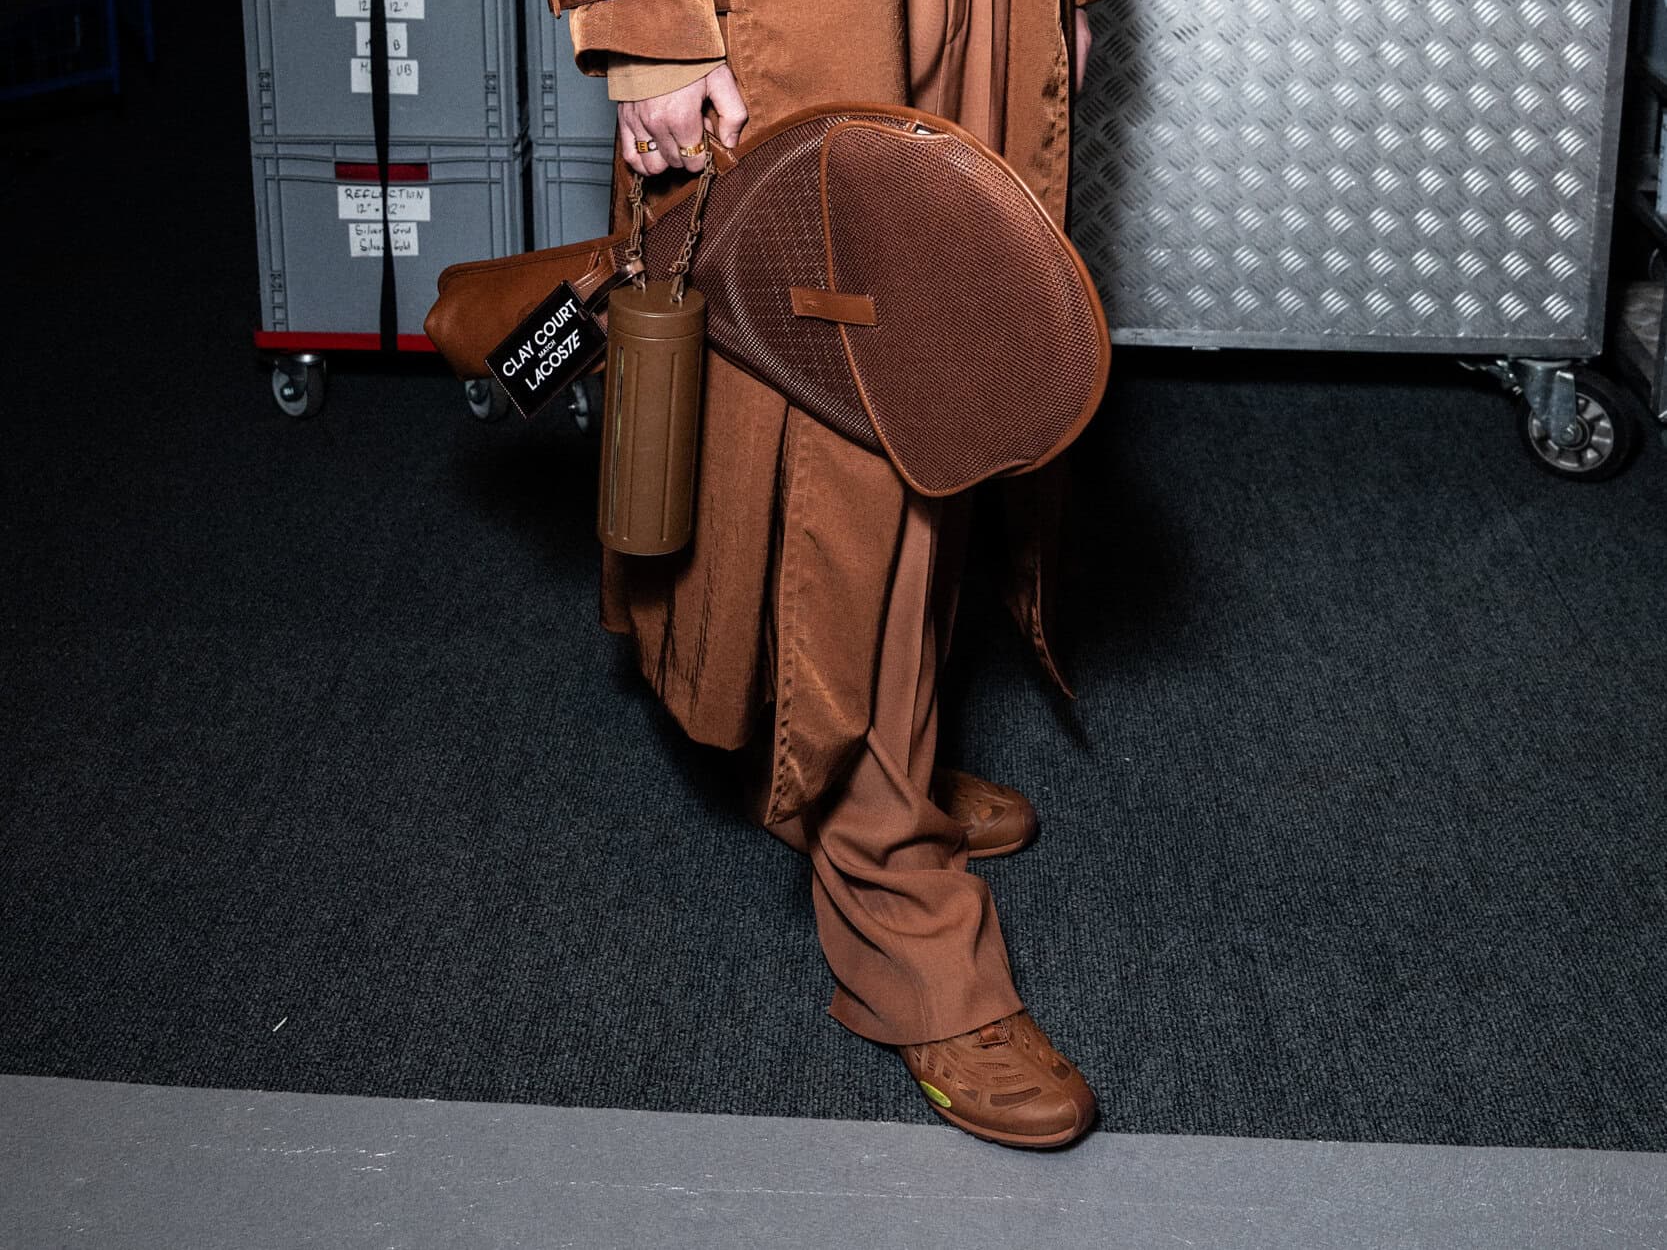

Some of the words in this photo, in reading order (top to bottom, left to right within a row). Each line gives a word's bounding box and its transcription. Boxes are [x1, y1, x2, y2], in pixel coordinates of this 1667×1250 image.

[345, 188, 425, 200] REFLCTION
[502, 340, 535, 377] CLAY
[534, 298, 577, 345] COURT
[525, 329, 581, 390] LACOSTE
